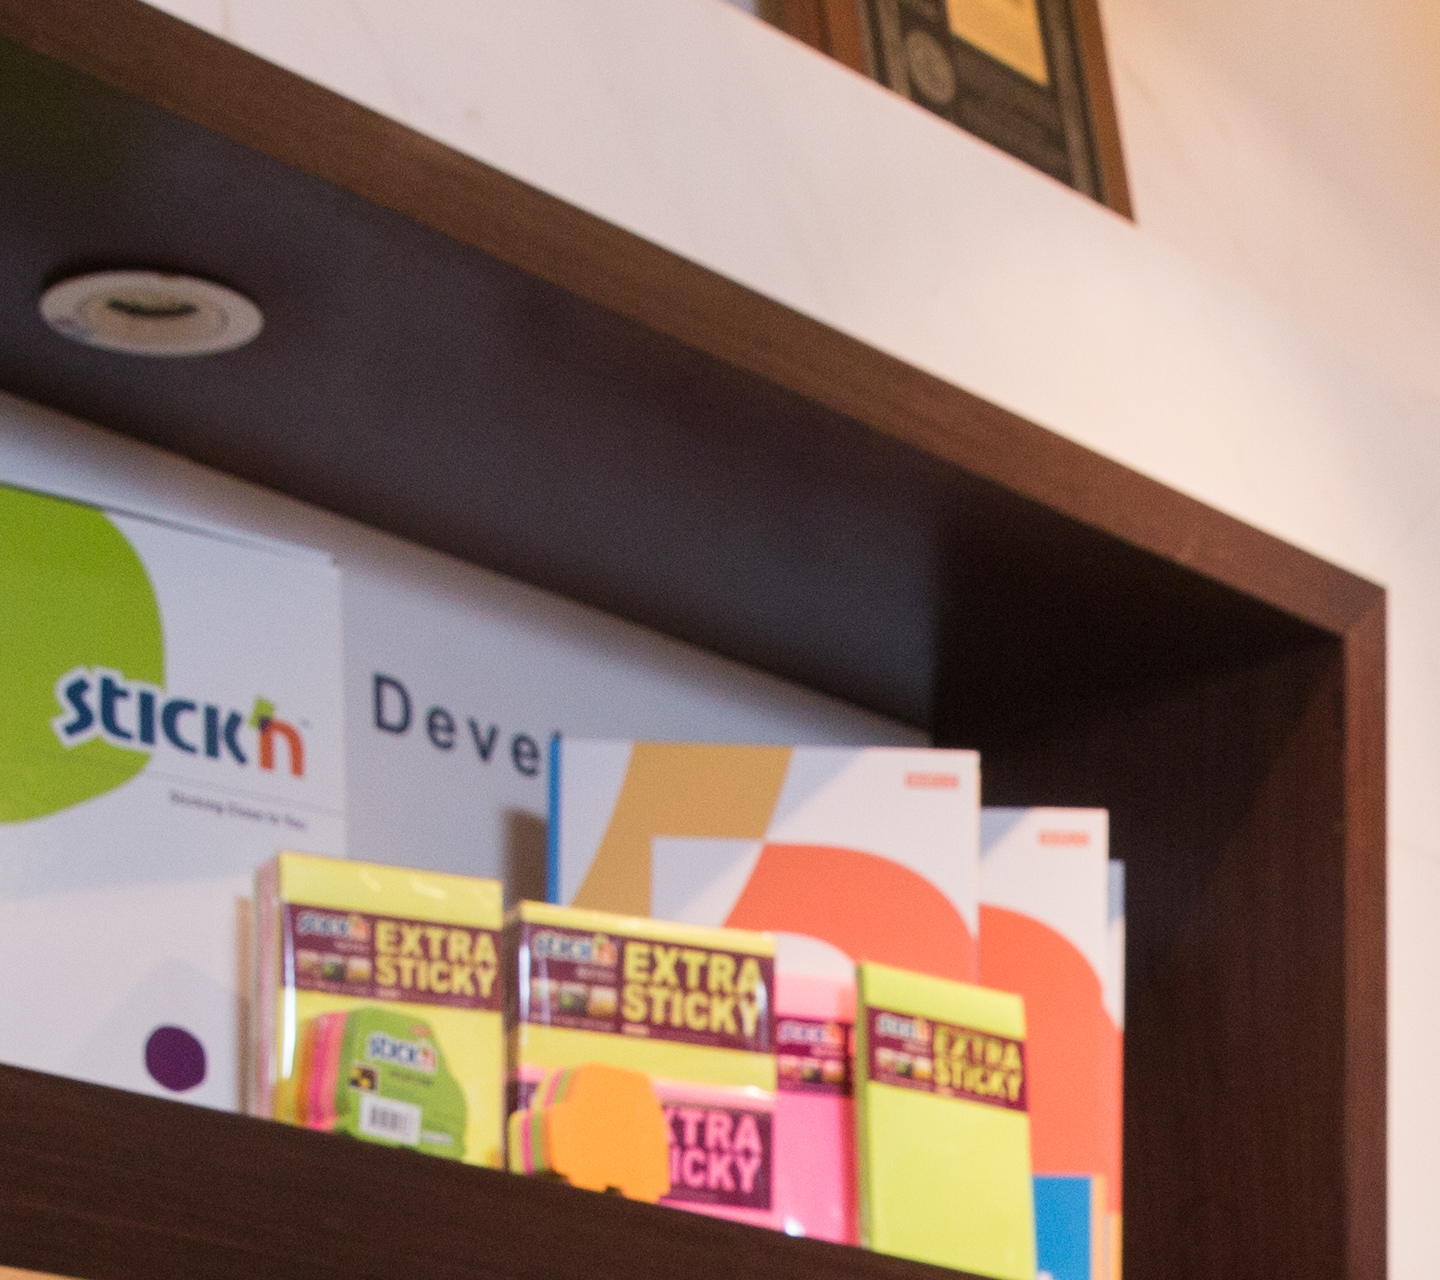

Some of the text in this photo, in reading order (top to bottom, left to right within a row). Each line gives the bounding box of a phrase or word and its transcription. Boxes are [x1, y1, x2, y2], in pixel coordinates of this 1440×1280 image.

[372, 672, 542, 778] Deve
[374, 919, 498, 966] EXTRA
[374, 954, 498, 998] STICKY
[623, 940, 761, 999] EXTRA
[621, 984, 760, 1037] STICKY
[662, 1106, 761, 1151] XTRA
[668, 1148, 760, 1193] ICKY
